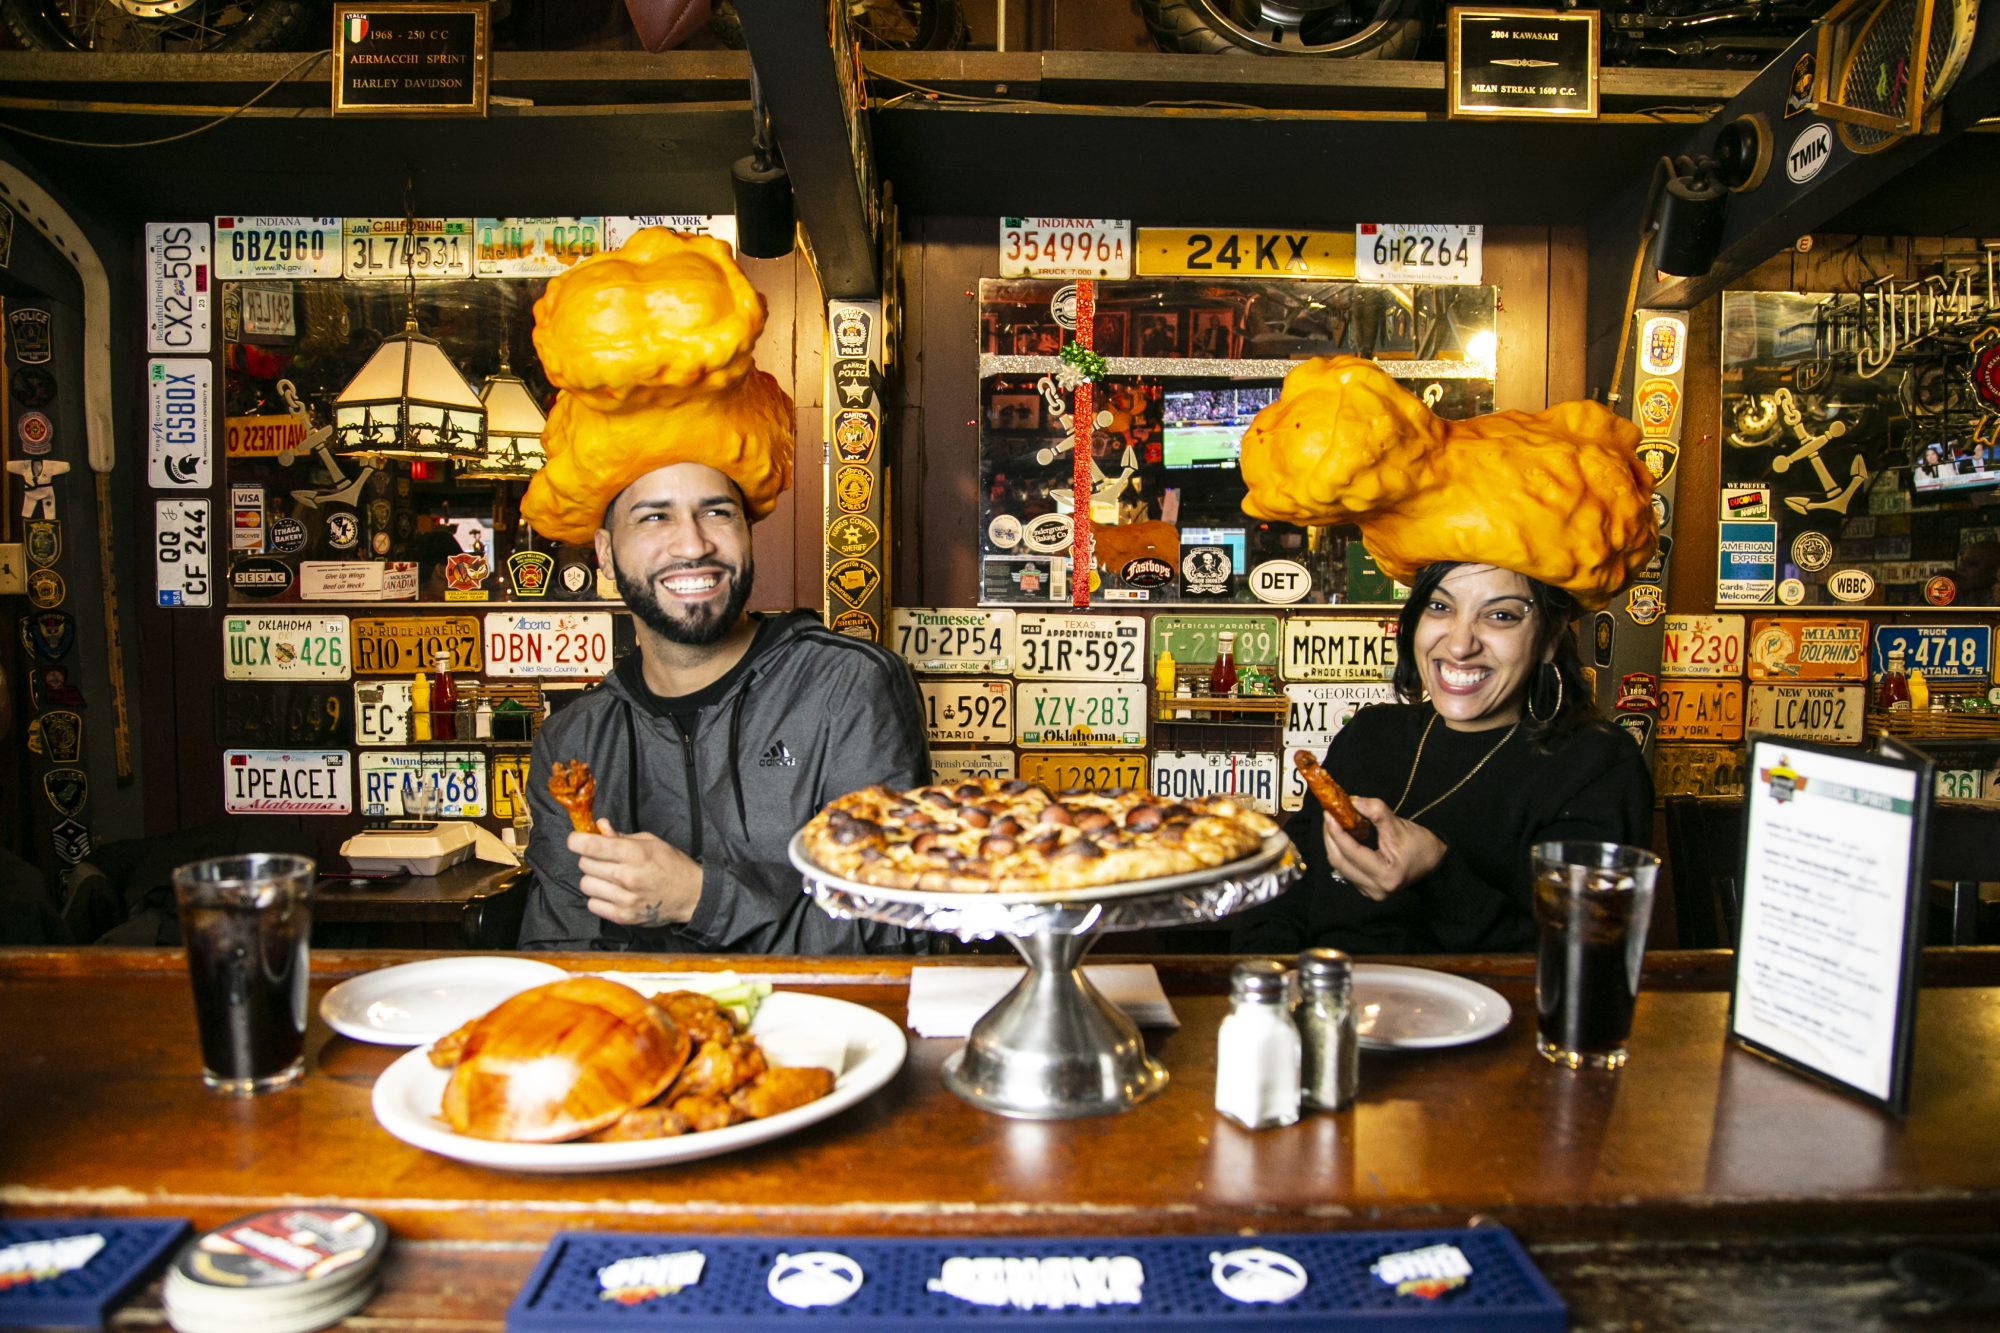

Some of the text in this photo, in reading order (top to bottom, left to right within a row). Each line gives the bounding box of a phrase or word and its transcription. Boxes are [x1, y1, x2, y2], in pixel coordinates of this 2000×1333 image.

[370, 30, 425, 40] 1968 250
[1491, 30, 1559, 41] 2004 KAWASAKI
[350, 54, 466, 64] AERMACCHI SPRINT
[352, 79, 463, 88] HARLEY DAVIDSON
[1471, 84, 1498, 93] MEAN
[1501, 85, 1536, 94] STREAK
[1539, 86, 1557, 95] 1600
[1790, 133, 1828, 174] TMIK
[256, 218, 301, 227] INDIANA
[517, 217, 558, 225] FLORIDA
[638, 216, 702, 225] NEW YORK
[1037, 218, 1094, 228] INDIANA
[352, 221, 443, 234] JAN CALIFORNIA
[1393, 224, 1449, 233] INDIANA
[232, 230, 324, 261] 6B2960
[482, 227, 523, 259] AJN
[1007, 231, 1124, 262] 354996A
[352, 237, 462, 268] 3L74531
[1374, 234, 1468, 267] 6H2264
[255, 264, 301, 272] www.IN.gov
[155, 277, 163, 303] British
[163, 227, 192, 346] CX2 50S
[198, 299, 205, 308] 23
[13, 313, 48, 324] POLICE
[156, 305, 164, 340] Beautiful
[153, 366, 162, 379] JAN
[152, 395, 164, 440] MICHIGAN
[238, 494, 259, 503] VISA
[1740, 506, 1767, 517] NOVUS
[184, 509, 207, 555] 244
[274, 526, 300, 536] ITHACA
[831, 518, 874, 536] KINGS COUNTY
[275, 533, 303, 543] BAKERY
[159, 531, 181, 563] QQ
[842, 544, 867, 552] SHERIFF
[1721, 543, 1772, 551] AMERICAN
[1732, 554, 1775, 563] EXPRESS
[1126, 560, 1171, 580] Fastboys
[1261, 572, 1299, 589] DET
[1837, 578, 1866, 594] WBBC
[1634, 587, 1658, 598] NYPD
[1719, 583, 1743, 591] Cards
[173, 590, 181, 605] USA
[1719, 592, 1760, 600] Welcome
[513, 617, 550, 631] Alberta
[915, 613, 985, 625] Tennessee
[1065, 620, 1096, 629] TEXAS
[258, 620, 312, 631] OKLAHOMA
[401, 627, 414, 637] DE
[417, 624, 470, 636] JANEIRO
[1047, 630, 1113, 639] APPORTIONED
[1803, 628, 1860, 640] MIAMI
[898, 626, 1001, 655] 70-2P54
[230, 636, 342, 666] UCX 426
[1022, 640, 1136, 672] 31R 592
[1293, 637, 1395, 665] MRMIKE
[1800, 644, 1858, 663] DOLPHINS
[1311, 668, 1377, 677] RHODE ISLAND
[1778, 688, 1834, 698] NEW YORK
[958, 696, 1007, 728] 592
[1289, 703, 1327, 731] AXI
[1774, 700, 1846, 730] LC4092
[1043, 727, 1116, 742] Oklahoma
[1656, 726, 1710, 735] NEW YORK
[390, 757, 445, 766] Minnesota
[759, 757, 796, 767] adidas
[935, 760, 1002, 768] British Columbia
[1157, 769, 1270, 800] BONJOUR
[239, 799, 335, 810] Alabama
